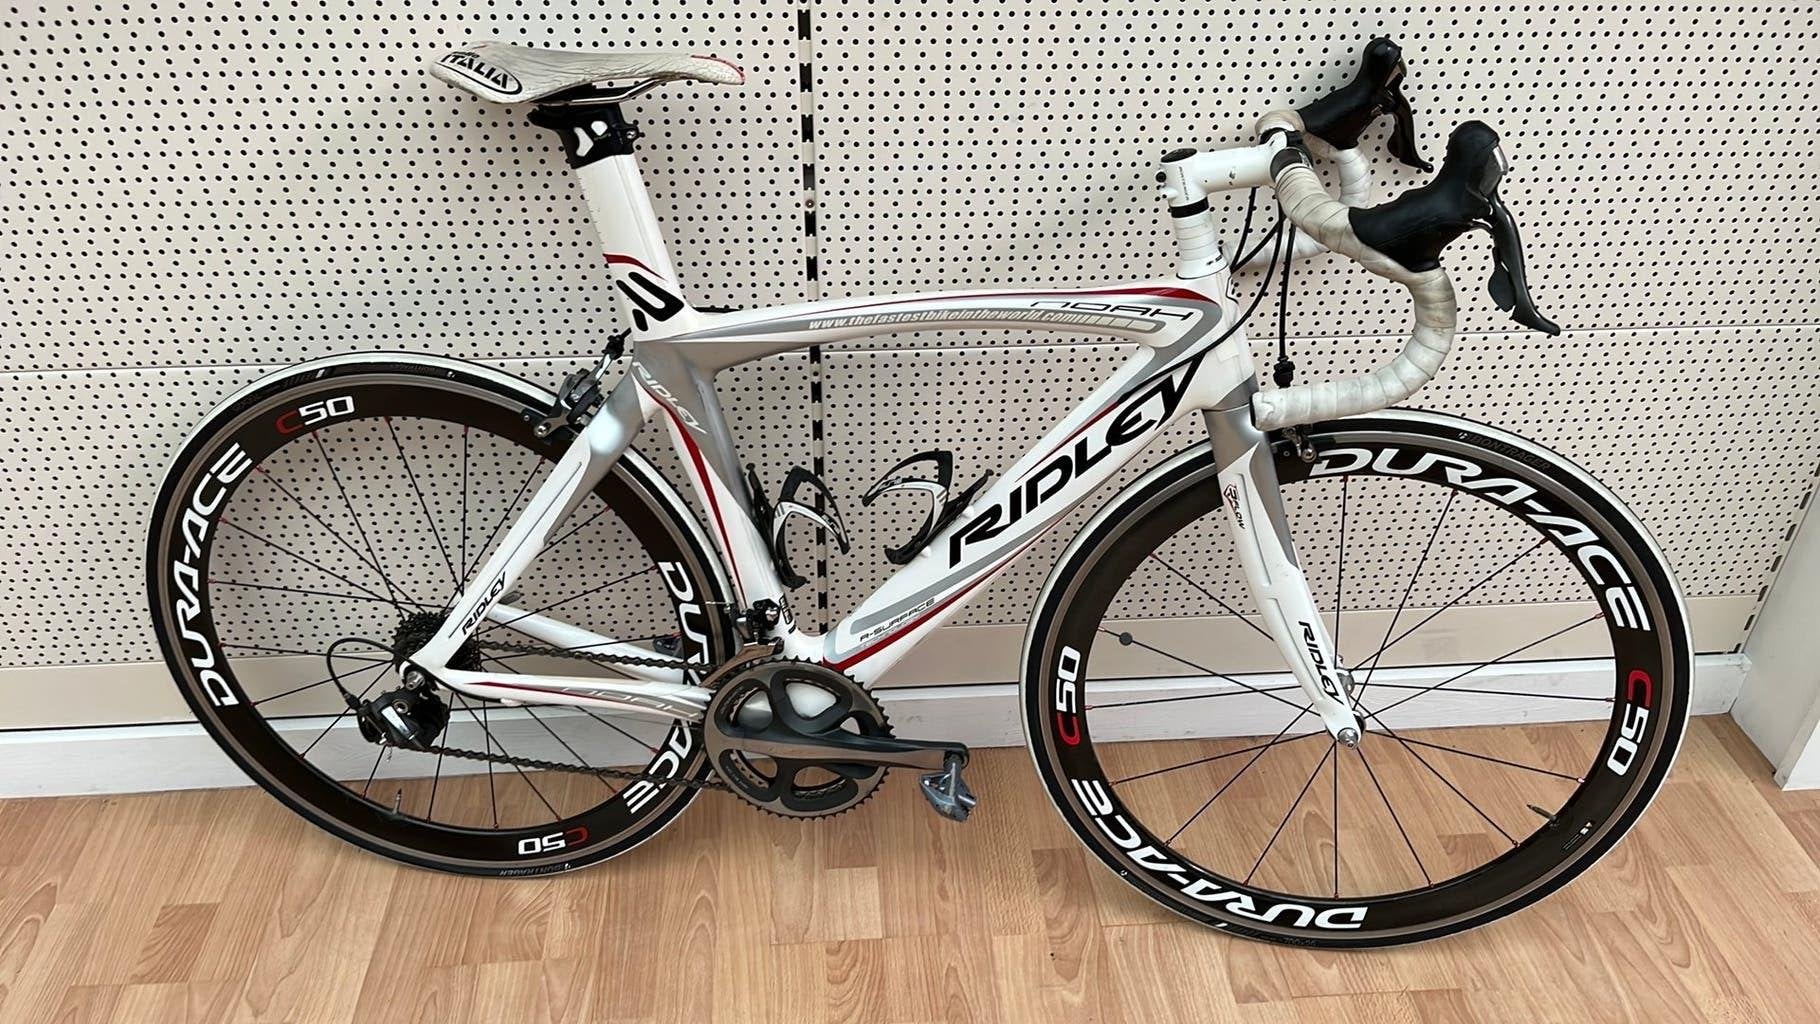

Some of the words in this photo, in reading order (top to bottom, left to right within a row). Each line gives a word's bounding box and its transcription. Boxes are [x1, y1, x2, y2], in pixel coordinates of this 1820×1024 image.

[440, 54, 509, 89] ITALIA
[808, 308, 1078, 330] www.thefastestbikeintheworld.com
[275, 395, 356, 435] C50
[949, 351, 1206, 569] RIDLEY
[173, 442, 253, 707] DURA-ACE
[1308, 447, 1651, 631] DURA-ACE
[462, 570, 506, 636] RIDLEY
[859, 597, 936, 643] R-SURFACE
[1055, 645, 1081, 746] C50
[1298, 620, 1345, 705] RIDLEY
[1606, 669, 1652, 776] C50
[518, 826, 588, 855] C50
[1071, 778, 1370, 930] DURA-ACE
